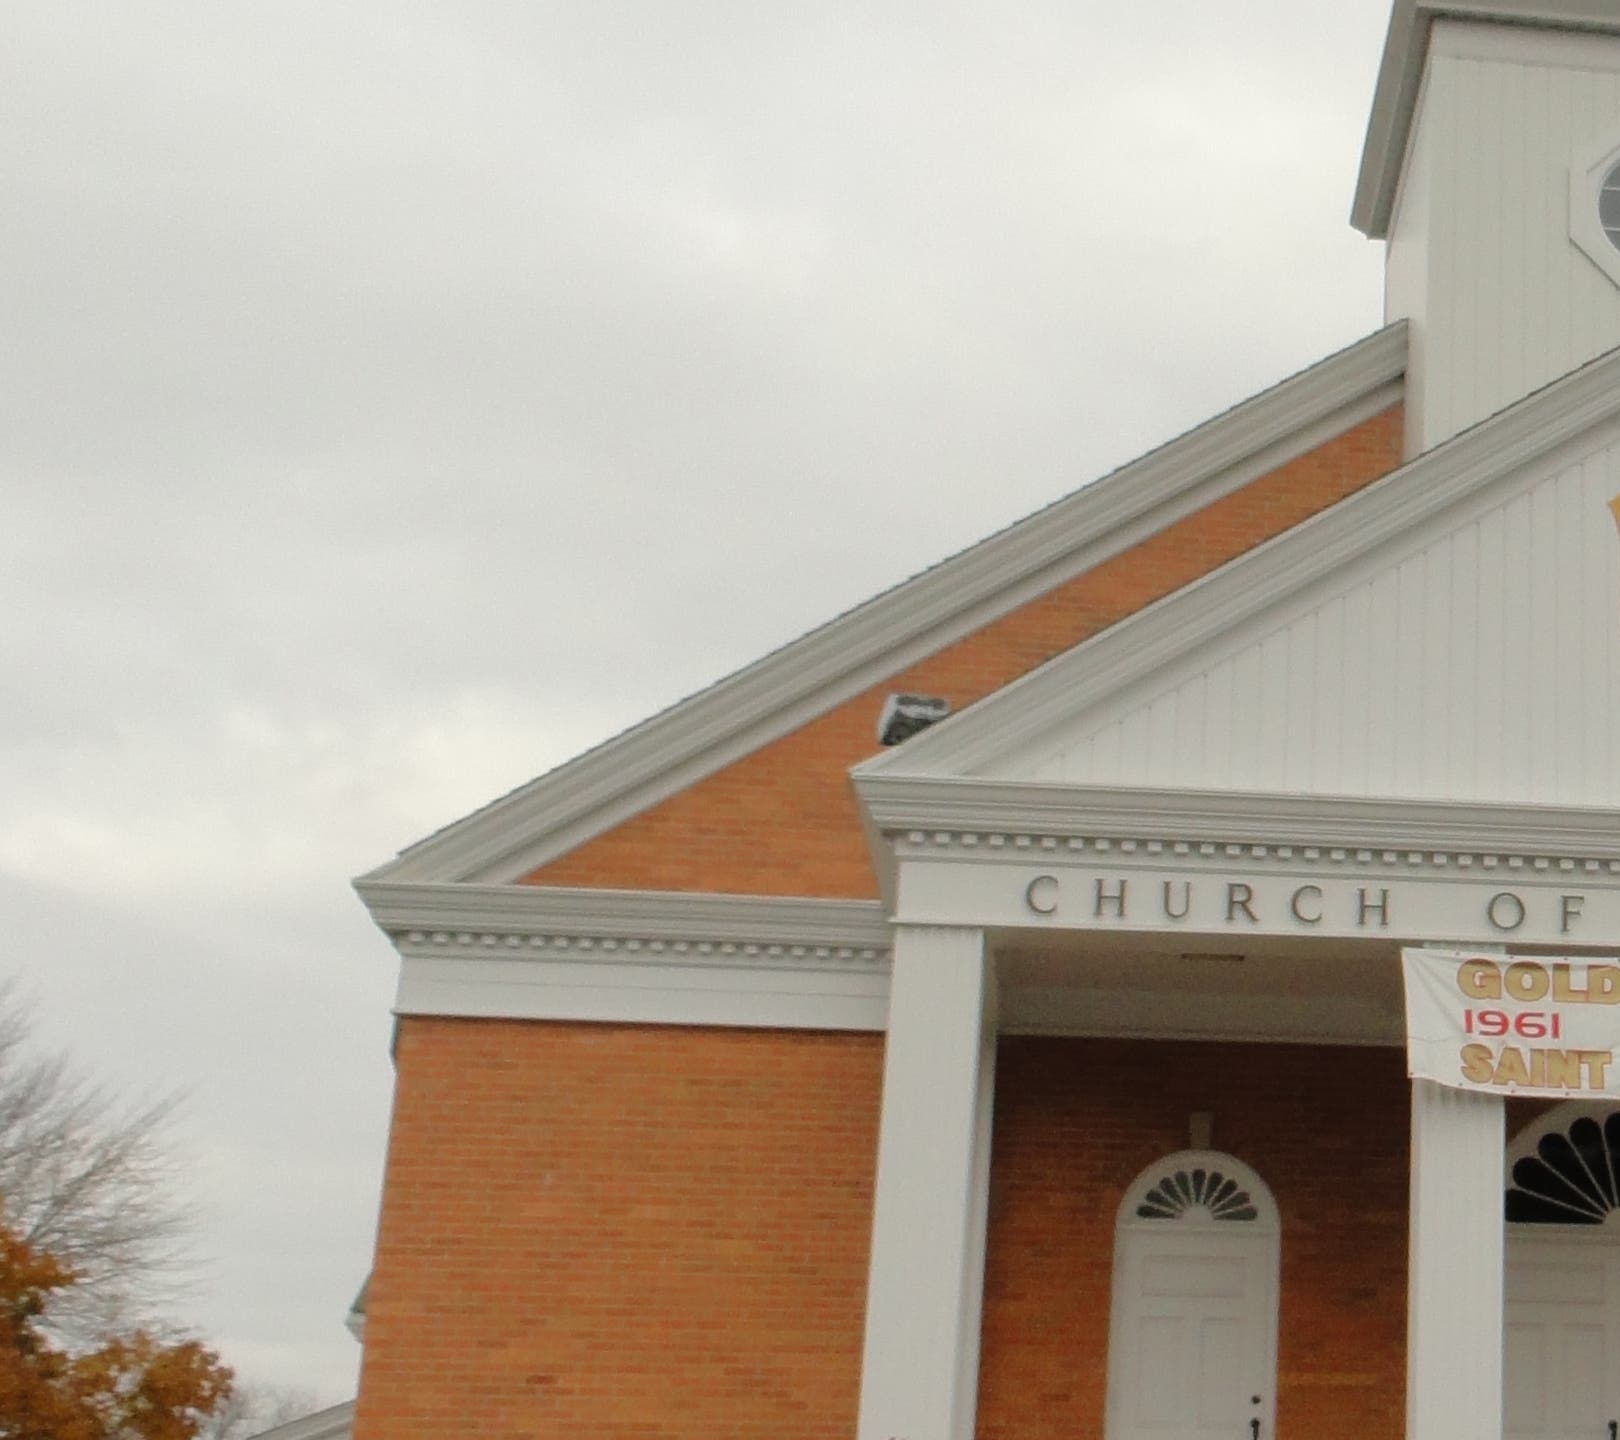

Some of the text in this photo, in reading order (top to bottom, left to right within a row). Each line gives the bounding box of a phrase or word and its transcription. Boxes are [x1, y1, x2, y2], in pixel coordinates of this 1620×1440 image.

[1024, 874, 1390, 927] CHURCH
[1486, 891, 1586, 933] OF
[1463, 1009, 1561, 1040] 1961
[1460, 1044, 1612, 1091] SAINT
